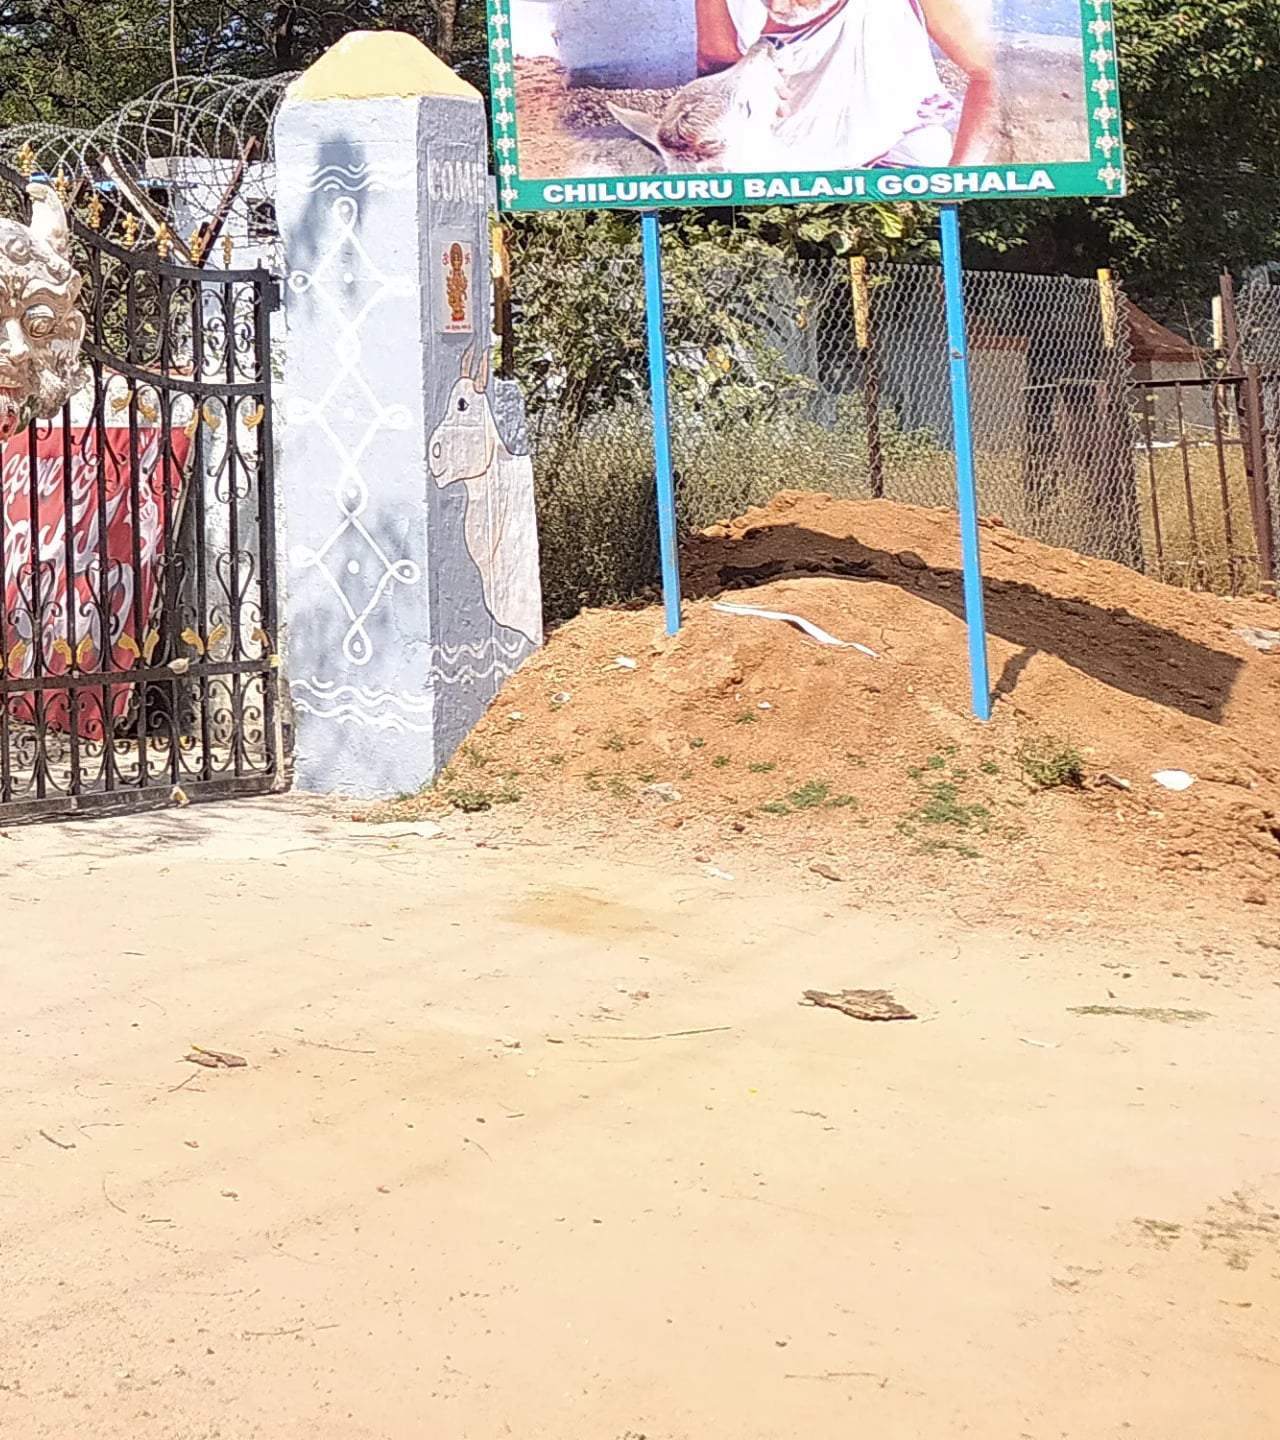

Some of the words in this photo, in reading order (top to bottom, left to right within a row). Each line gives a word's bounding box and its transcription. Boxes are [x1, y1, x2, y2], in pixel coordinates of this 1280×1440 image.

[542, 178, 734, 205] CHILUKURU
[744, 175, 867, 200] BALAJI
[876, 169, 1056, 196] GOSHALA
